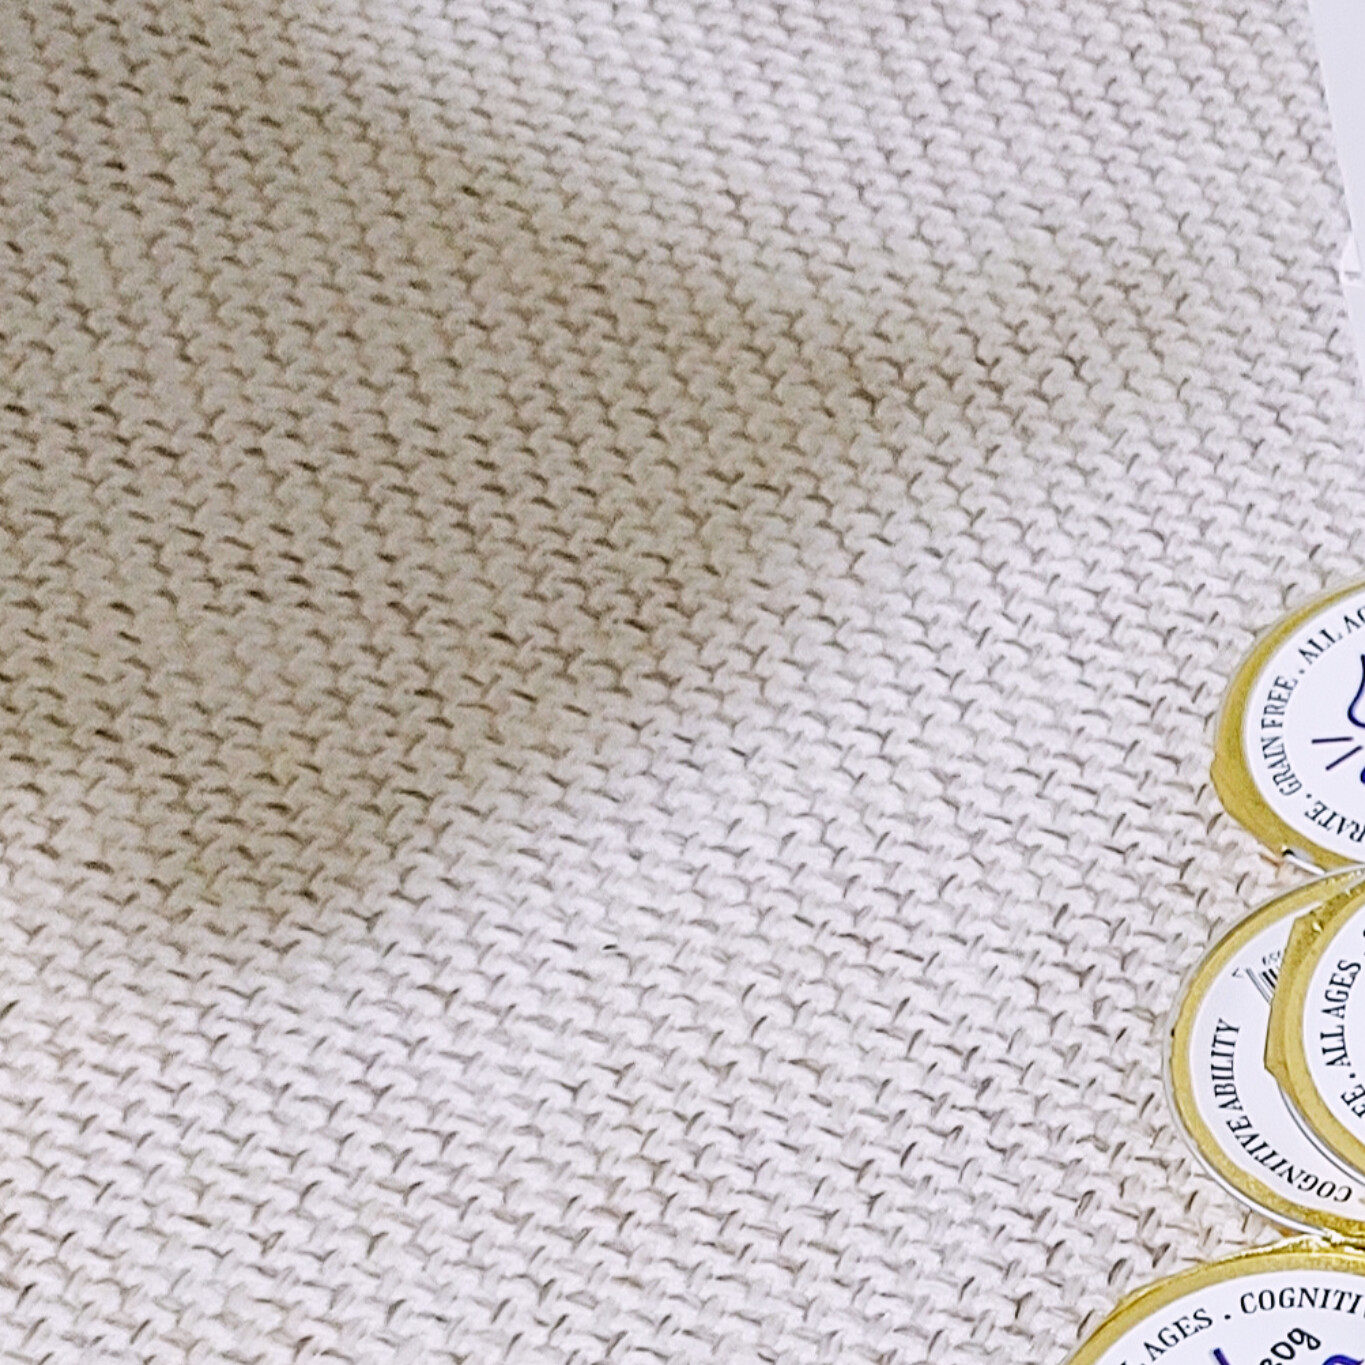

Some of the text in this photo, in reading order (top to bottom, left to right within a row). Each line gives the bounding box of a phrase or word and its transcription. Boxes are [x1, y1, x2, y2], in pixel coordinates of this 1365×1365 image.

[1298, 629, 1345, 665] ALL
[1260, 675, 1302, 797] GRAIN FREE
[1213, 1016, 1241, 1095] ABILITY
[1320, 959, 1362, 1069] ALL AGES
[1227, 1096, 1353, 1203] COGNITIVE
[1143, 1308, 1213, 1365] AGES
